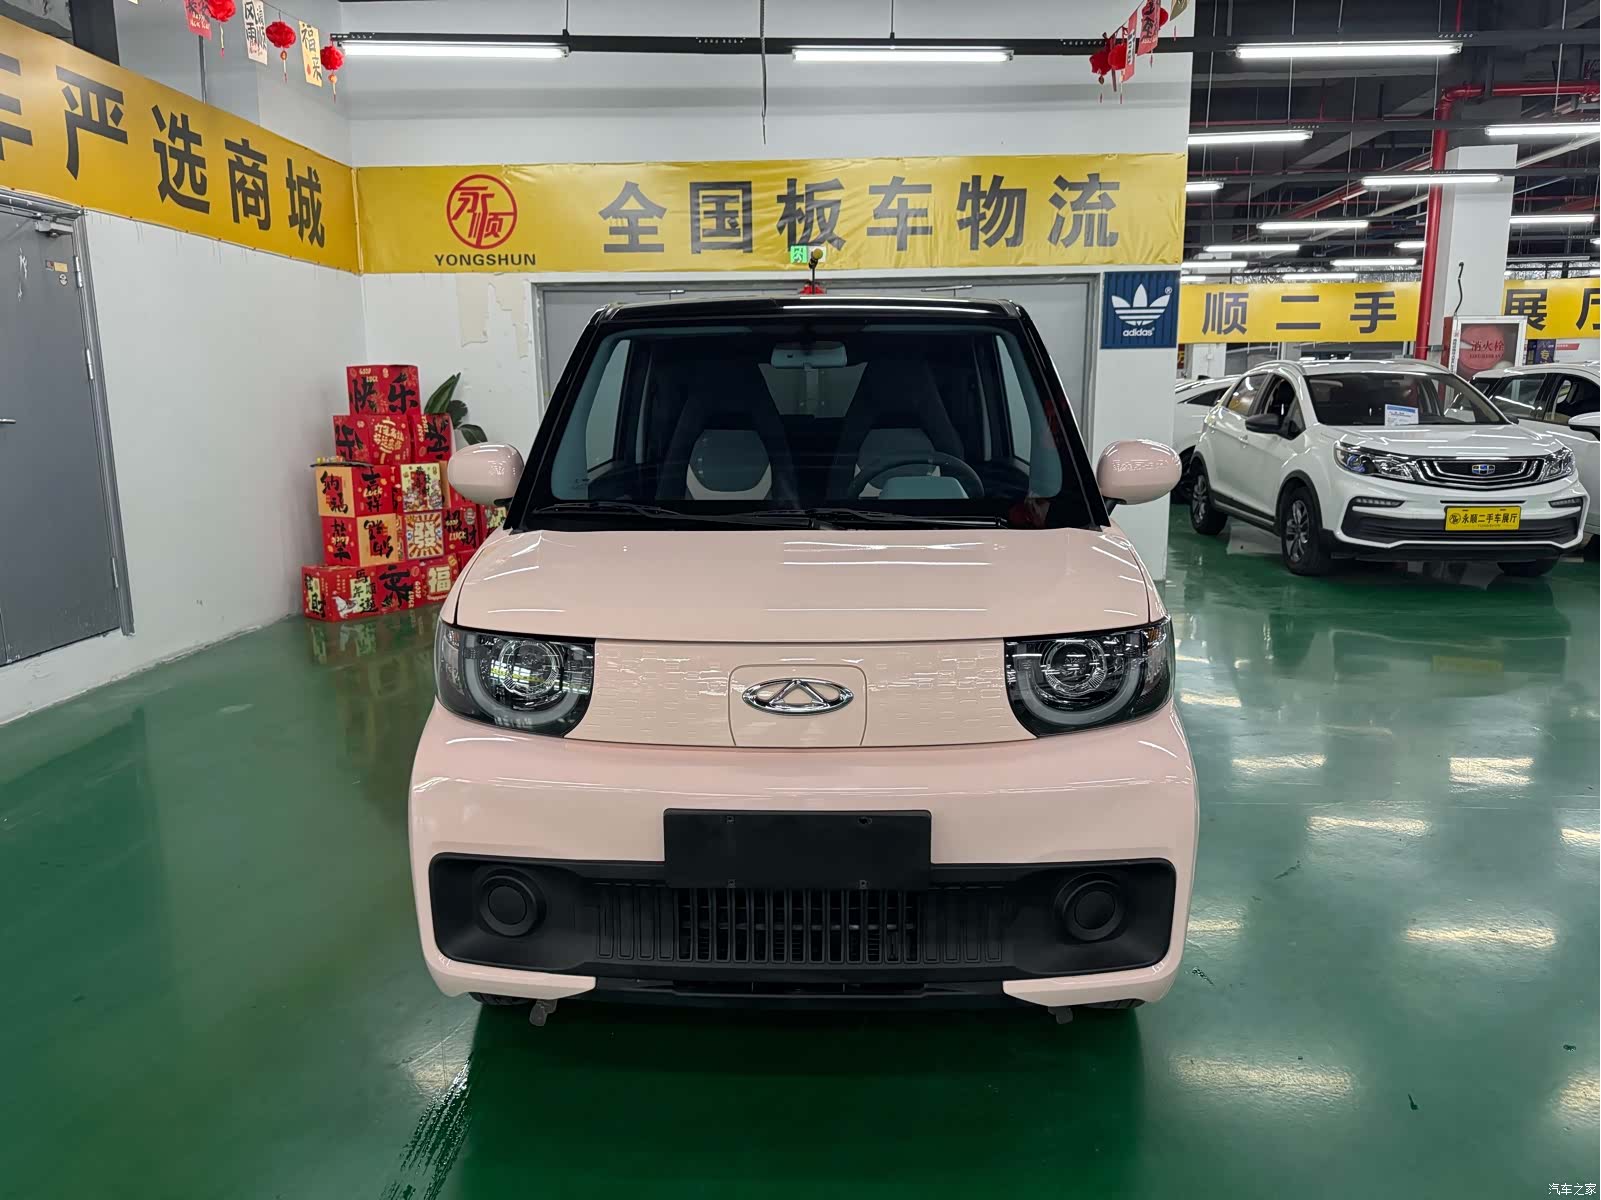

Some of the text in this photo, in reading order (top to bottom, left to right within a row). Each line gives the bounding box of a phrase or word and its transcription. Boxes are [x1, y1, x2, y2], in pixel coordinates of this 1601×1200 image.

[599, 173, 1120, 255] 全国板车物流
[434, 253, 536, 267] YONGSHUN
[1202, 290, 1397, 335] 顺二手
[1122, 327, 1154, 337] adidas
[349, 372, 419, 414] 快乐
[1461, 512, 1518, 524] 永顺二手车展厅
[428, 565, 451, 593] 福
